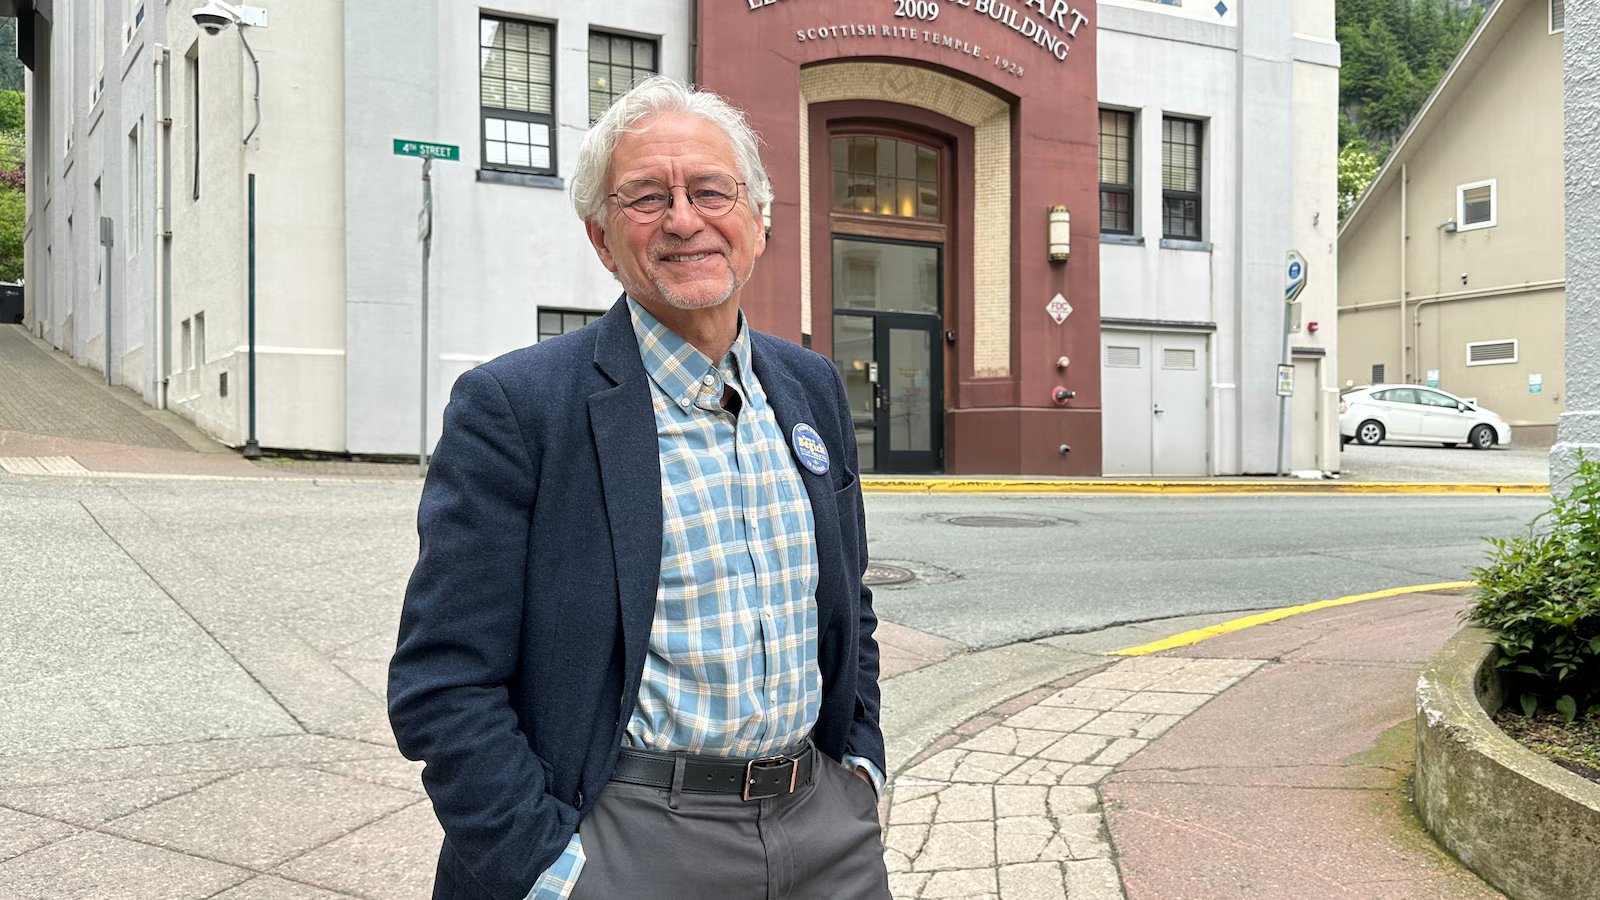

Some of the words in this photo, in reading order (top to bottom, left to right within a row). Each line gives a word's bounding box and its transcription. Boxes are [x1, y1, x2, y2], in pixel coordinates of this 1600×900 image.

[894, 0, 940, 21] 2009
[974, 0, 1070, 61] BUILDING
[796, 24, 877, 42] SCOTTISH
[882, 25, 918, 40] RITE
[922, 31, 981, 57] TEMPLE
[994, 55, 1025, 76] 1928
[402, 143, 417, 153] 4TH
[419, 144, 451, 157] STREET
[1051, 302, 1069, 311] FDC
